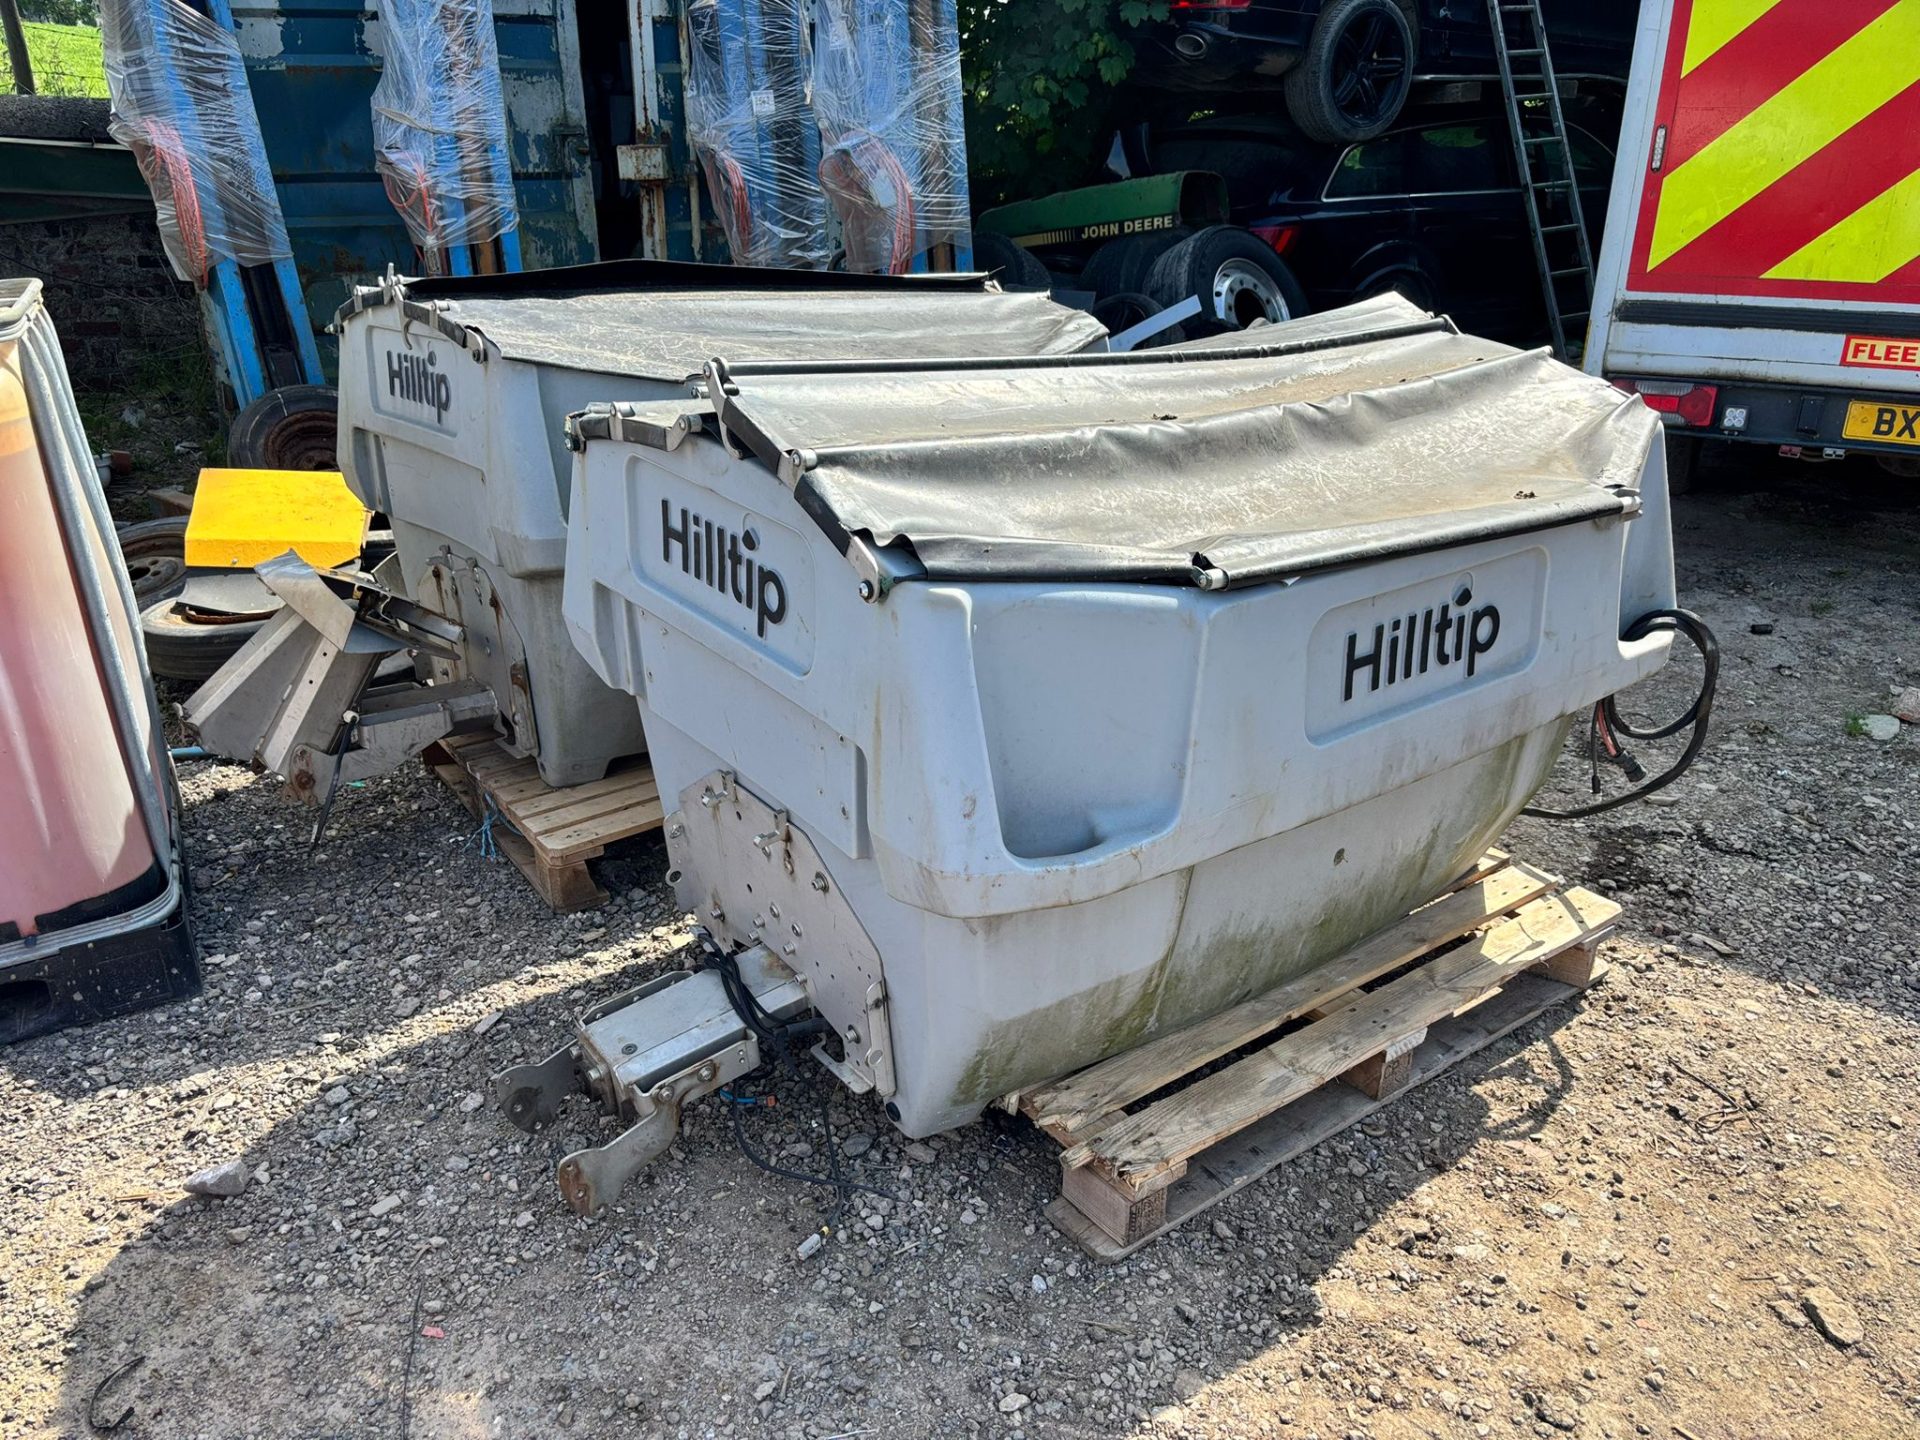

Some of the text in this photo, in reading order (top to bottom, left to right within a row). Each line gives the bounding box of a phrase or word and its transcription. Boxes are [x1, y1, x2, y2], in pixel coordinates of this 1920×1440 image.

[1081, 215, 1173, 239] JOHN DEERE
[386, 349, 452, 425] Hilltip
[1852, 343, 1919, 363] FLEE
[661, 498, 787, 639] Hilltip
[1343, 587, 1501, 702] Hilltip
